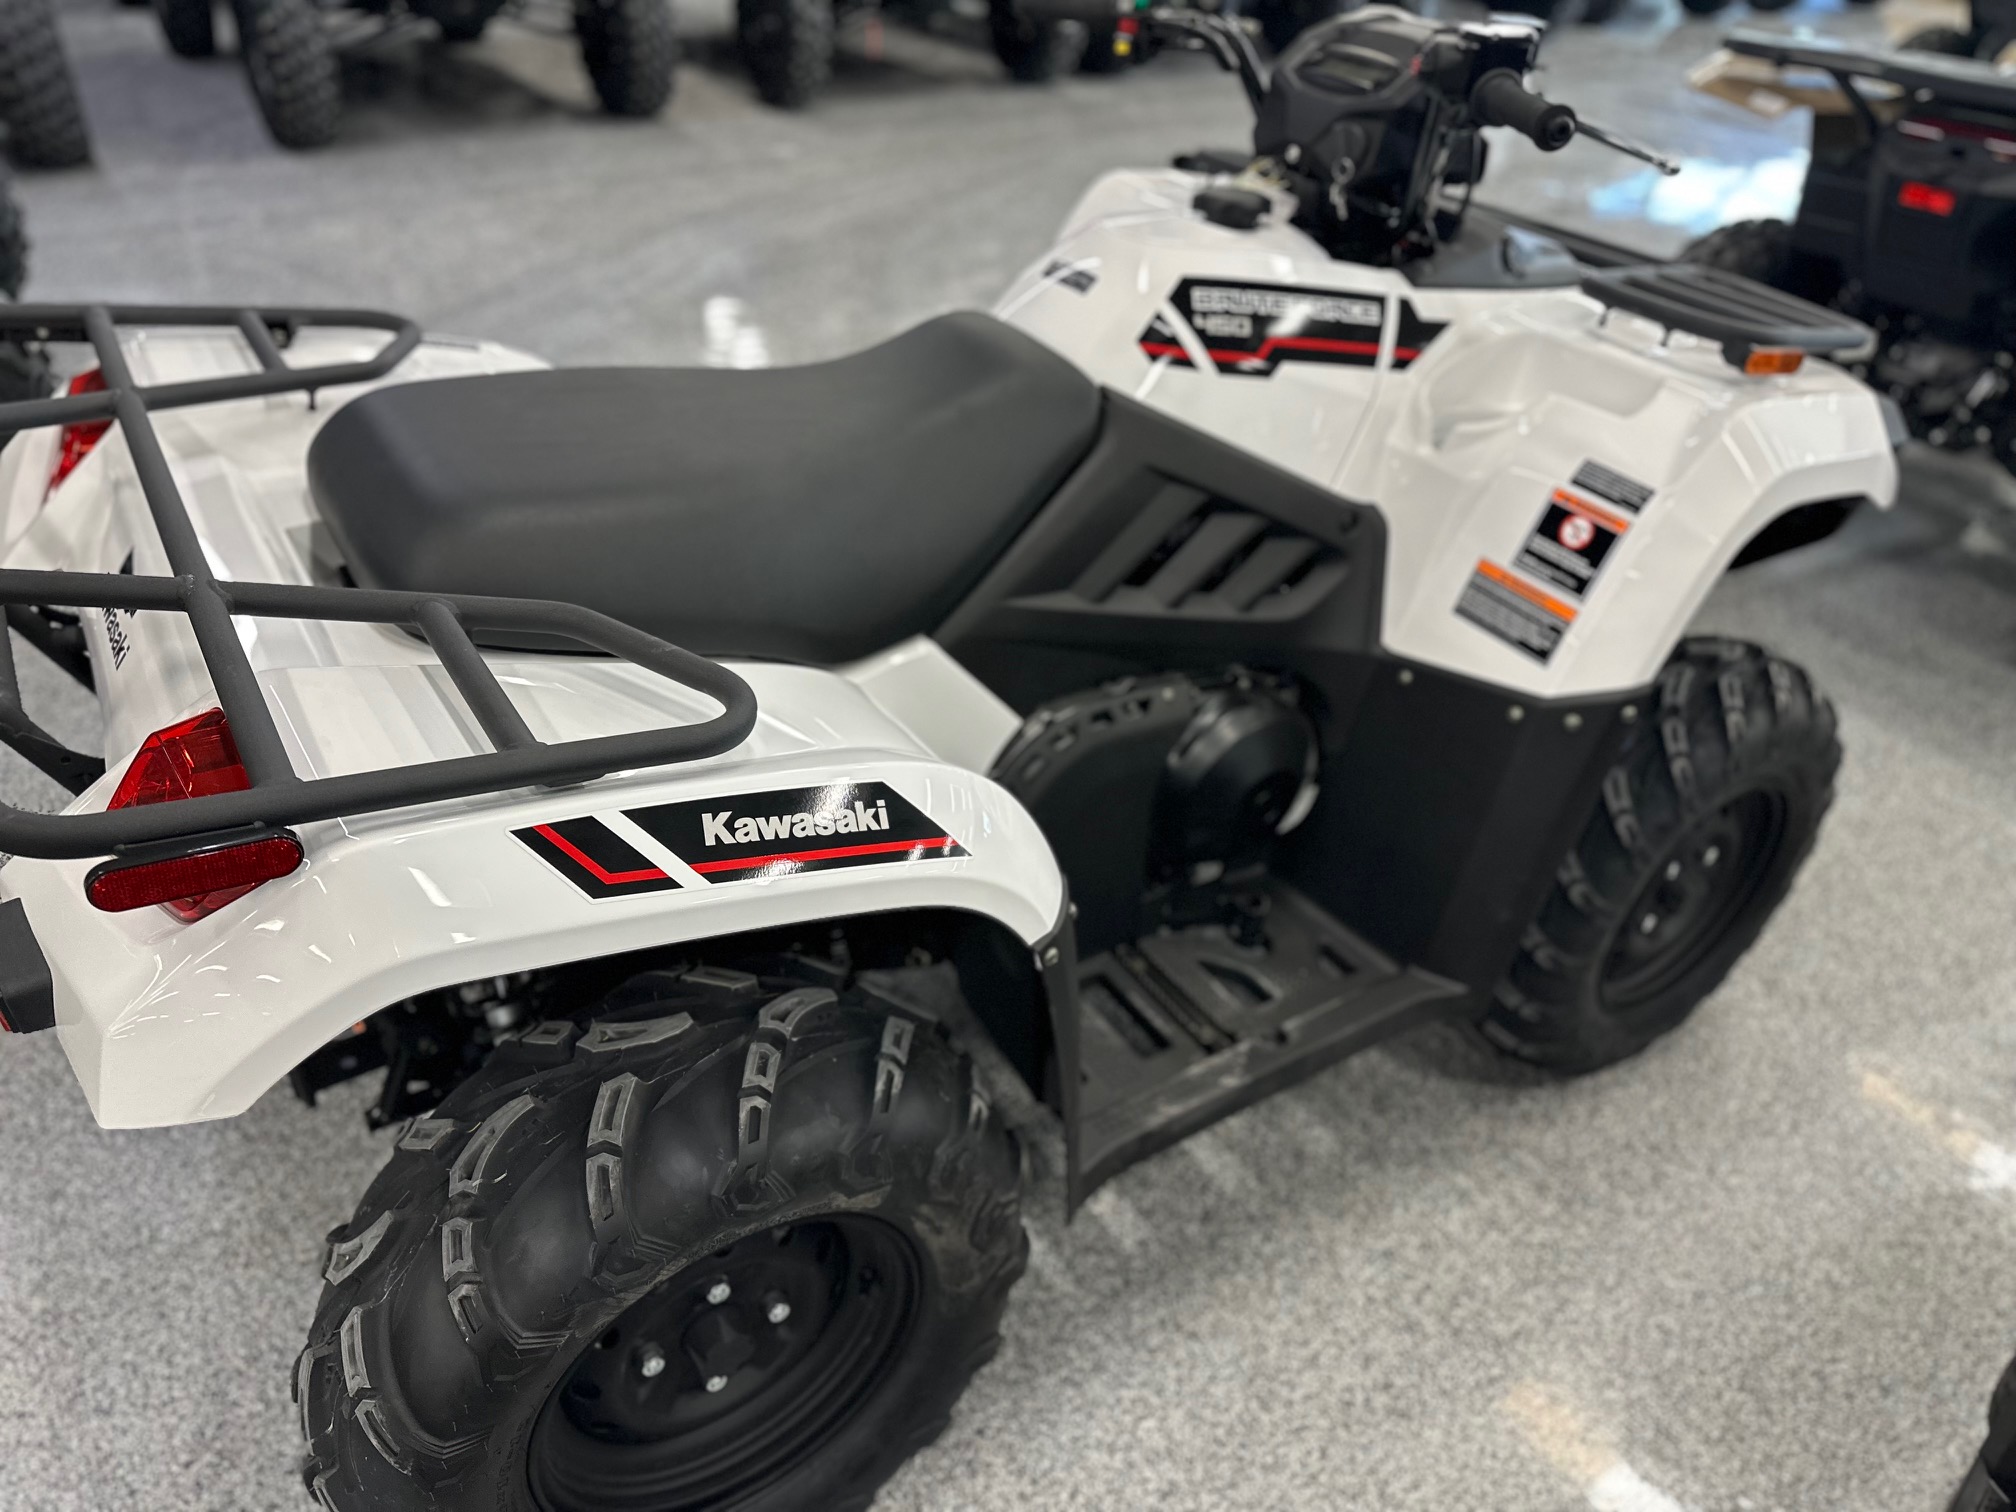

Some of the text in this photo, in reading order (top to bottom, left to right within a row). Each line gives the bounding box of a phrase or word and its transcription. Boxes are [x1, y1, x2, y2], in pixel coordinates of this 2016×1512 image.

[1288, 294, 1381, 327] ORCE
[102, 608, 130, 671] wasaki
[701, 799, 890, 846] Kawasaki
